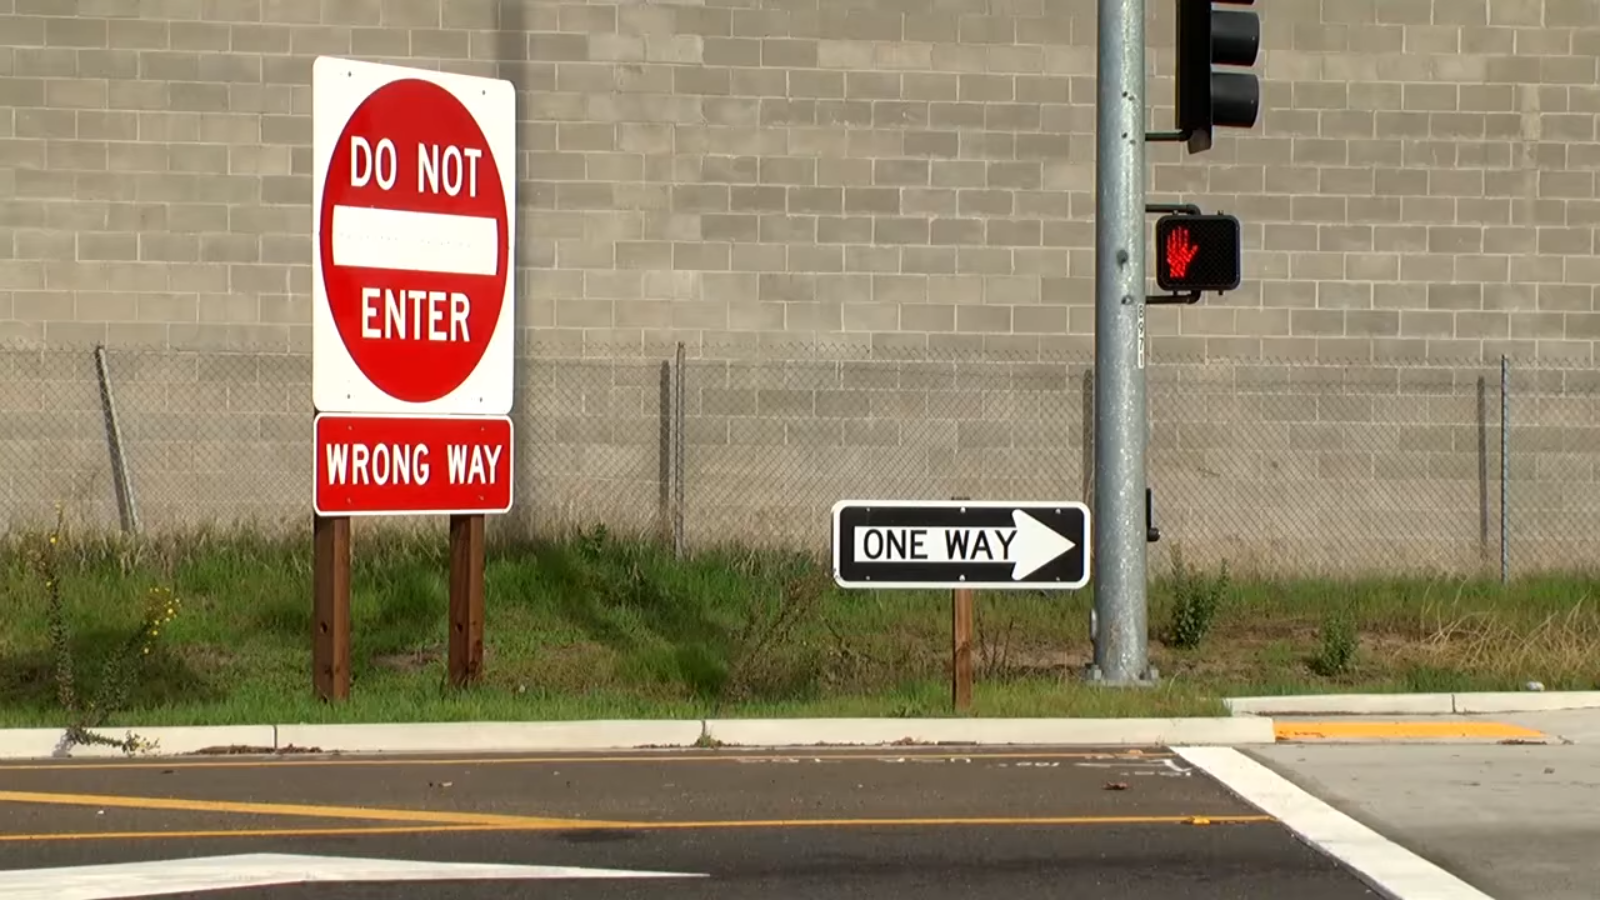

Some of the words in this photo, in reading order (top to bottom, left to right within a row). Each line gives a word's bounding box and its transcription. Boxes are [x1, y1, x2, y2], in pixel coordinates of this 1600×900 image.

[350, 135, 397, 190] DO
[418, 142, 482, 197] NOT
[361, 287, 470, 342] ENTER
[326, 443, 430, 485] WRONG
[447, 444, 502, 485] WAY
[863, 528, 929, 560] ONE
[944, 529, 1018, 560] WAY
